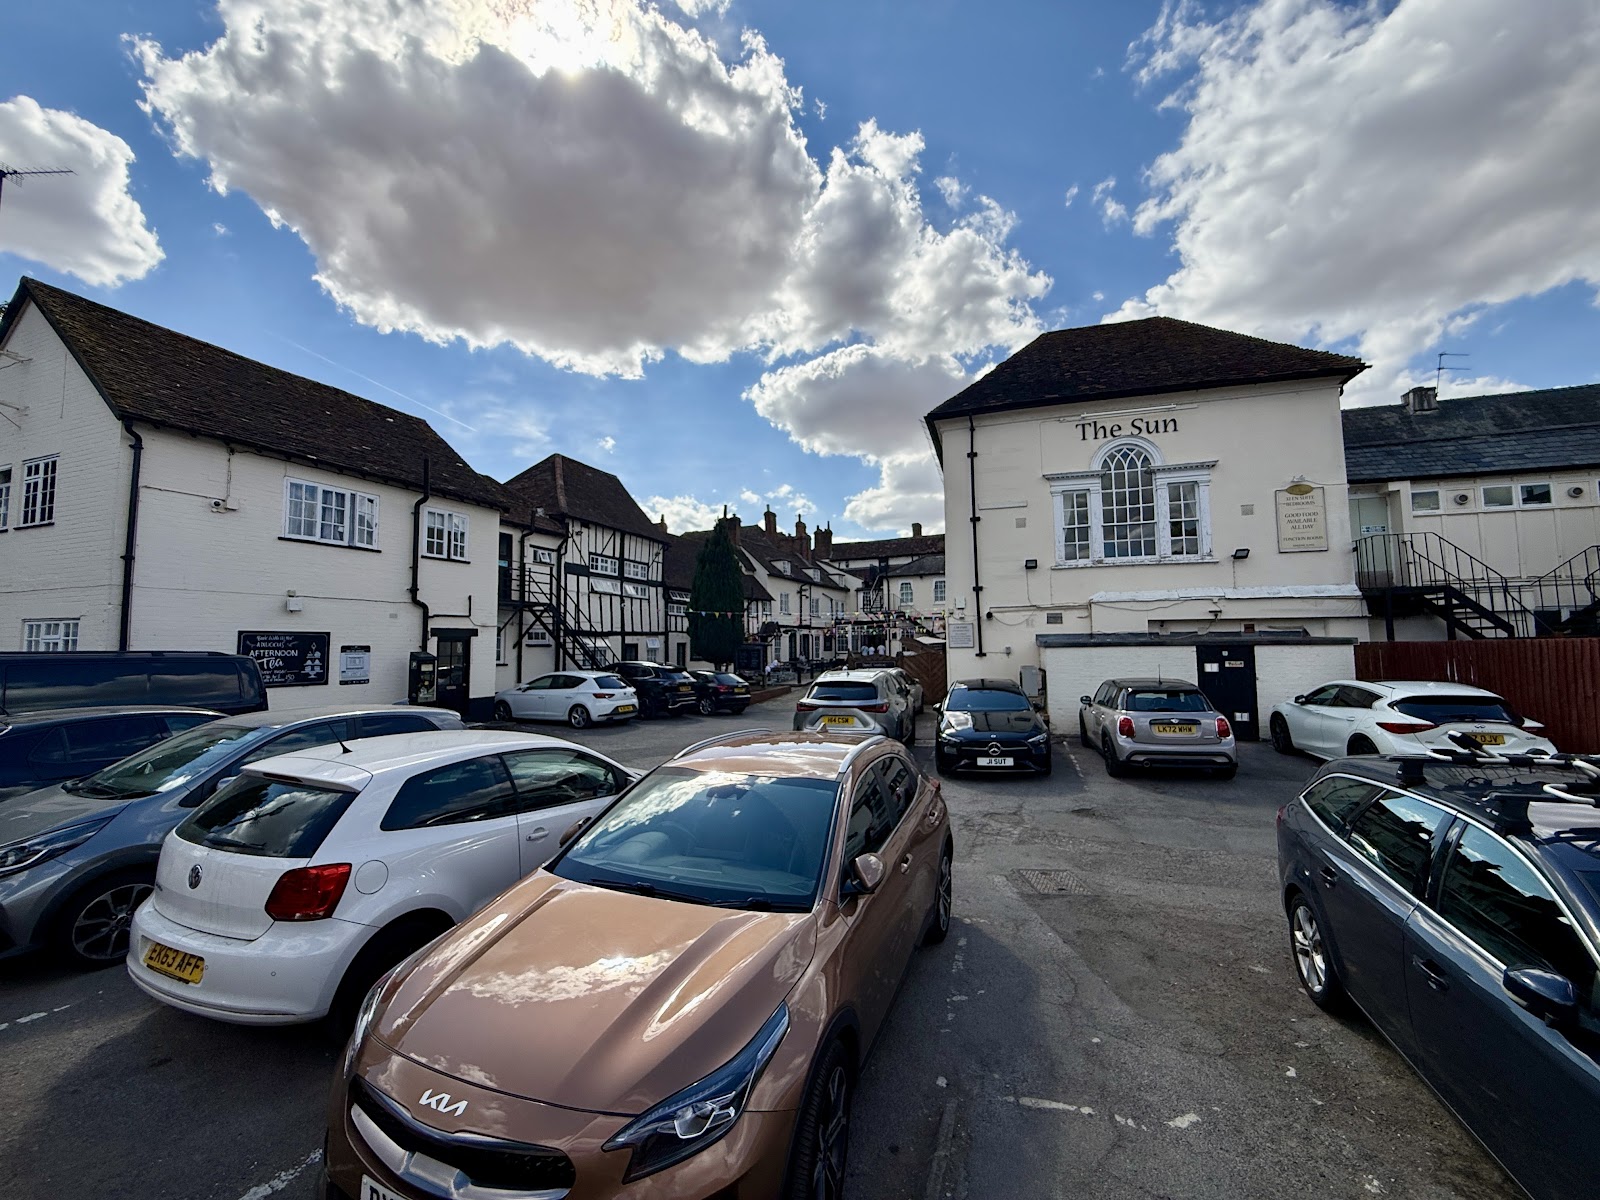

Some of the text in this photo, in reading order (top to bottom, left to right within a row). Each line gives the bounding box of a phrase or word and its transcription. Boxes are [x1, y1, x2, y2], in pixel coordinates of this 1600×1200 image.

[1076, 418, 1178, 440] The Sun
[256, 657, 285, 669] Tea
[148, 943, 201, 976] EK63 AFF
